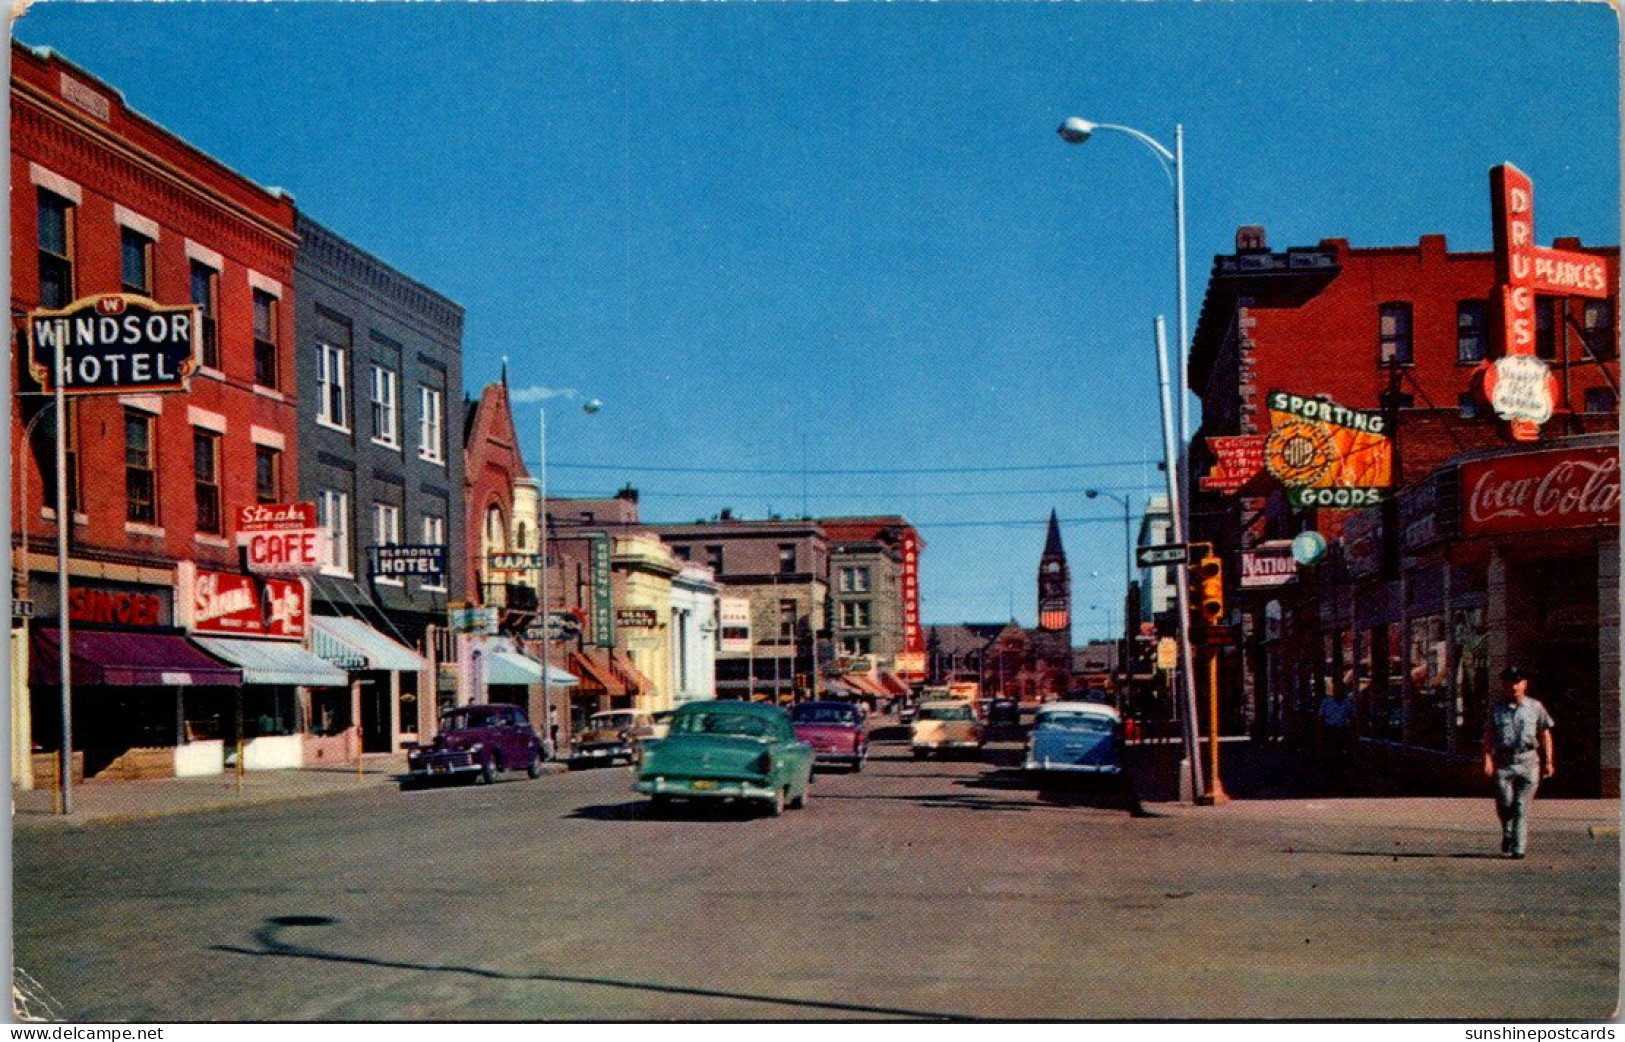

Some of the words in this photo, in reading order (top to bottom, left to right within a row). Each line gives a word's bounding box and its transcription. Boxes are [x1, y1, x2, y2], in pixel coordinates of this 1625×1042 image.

[1510, 187, 1531, 346] DRUGS
[1535, 257, 1605, 291] PEARCE'S
[103, 299, 119, 311] W
[35, 315, 190, 347] WINDSOR
[57, 353, 174, 384] HOTEL
[1275, 393, 1385, 432] SPORTING
[1301, 489, 1382, 505] GOODS
[241, 505, 305, 523] Steaks
[251, 533, 316, 564] CAFE
[381, 558, 440, 573] HOTEL
[69, 587, 159, 625] SINGER
[905, 539, 917, 647] PARAMOUNT
